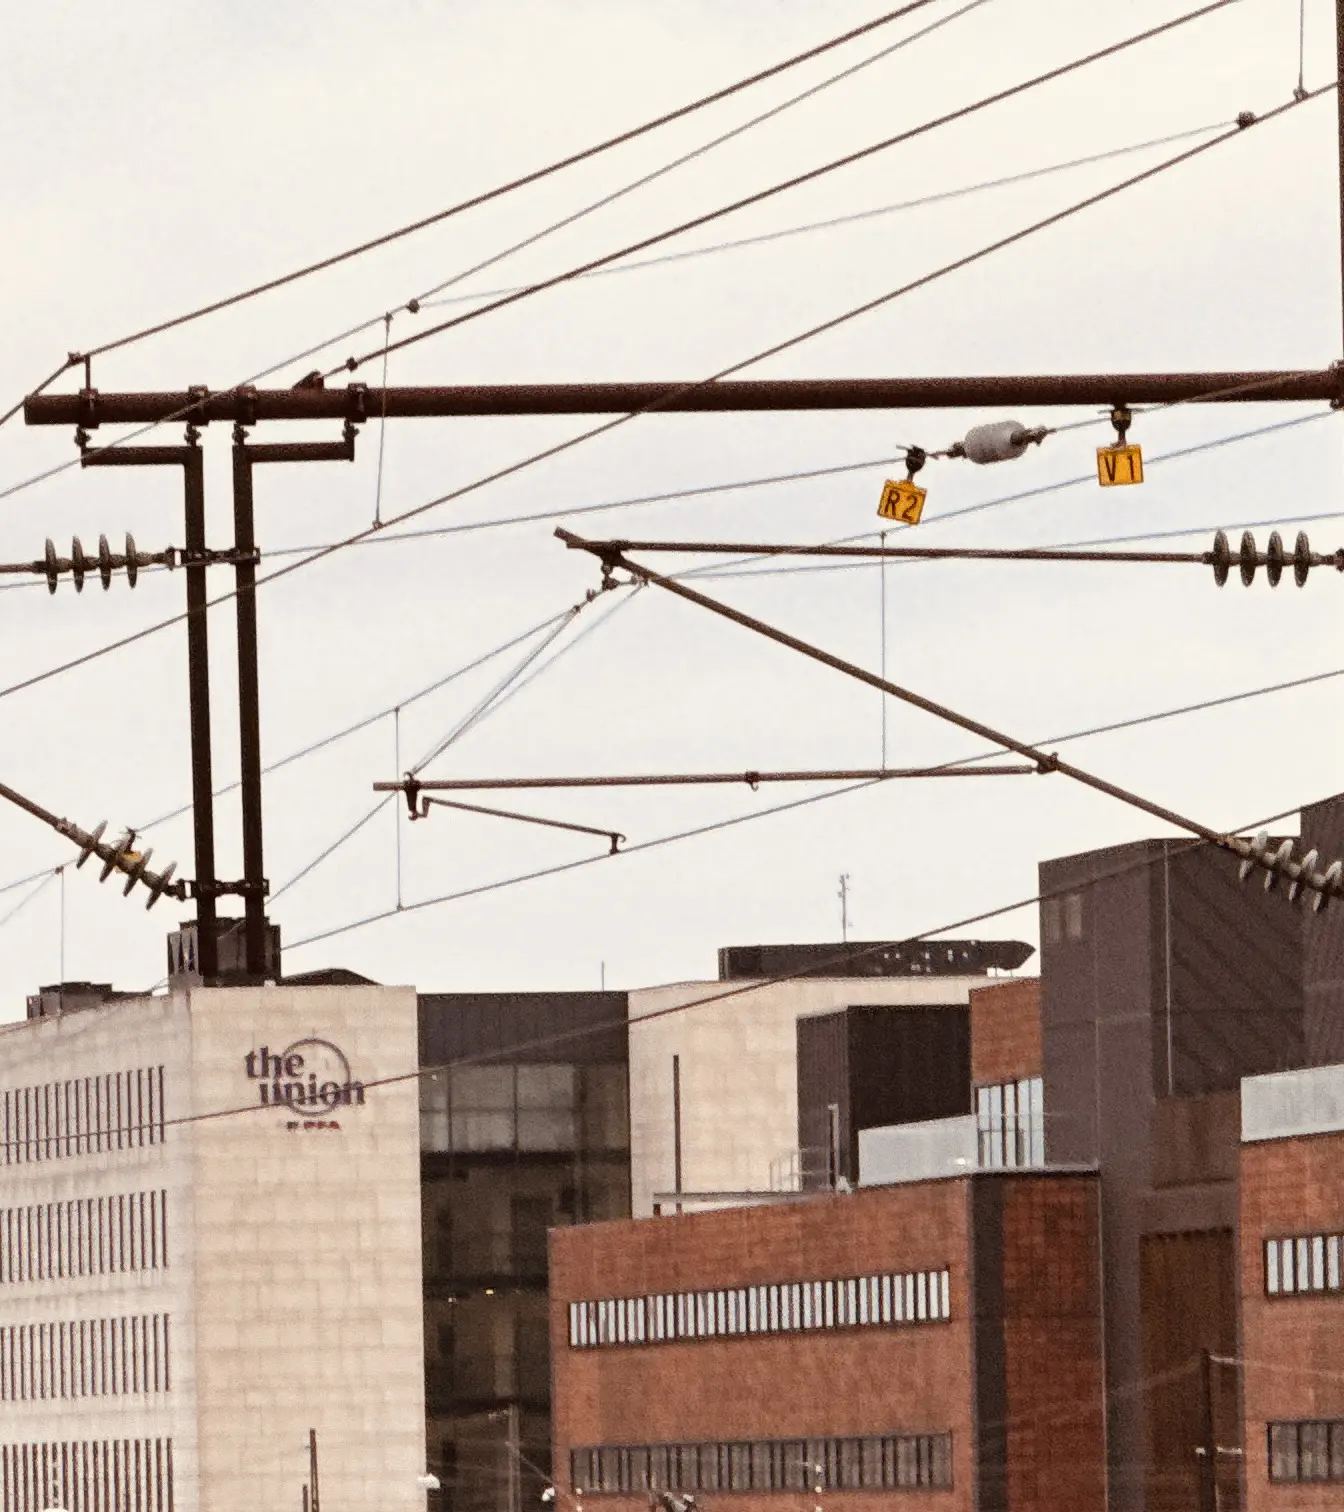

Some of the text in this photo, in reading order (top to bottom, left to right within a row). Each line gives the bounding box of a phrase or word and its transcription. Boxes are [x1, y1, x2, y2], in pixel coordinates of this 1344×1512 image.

[1104, 454, 1135, 482] V1
[884, 489, 918, 520] R2
[244, 1045, 305, 1079] the
[258, 1072, 366, 1106] union
